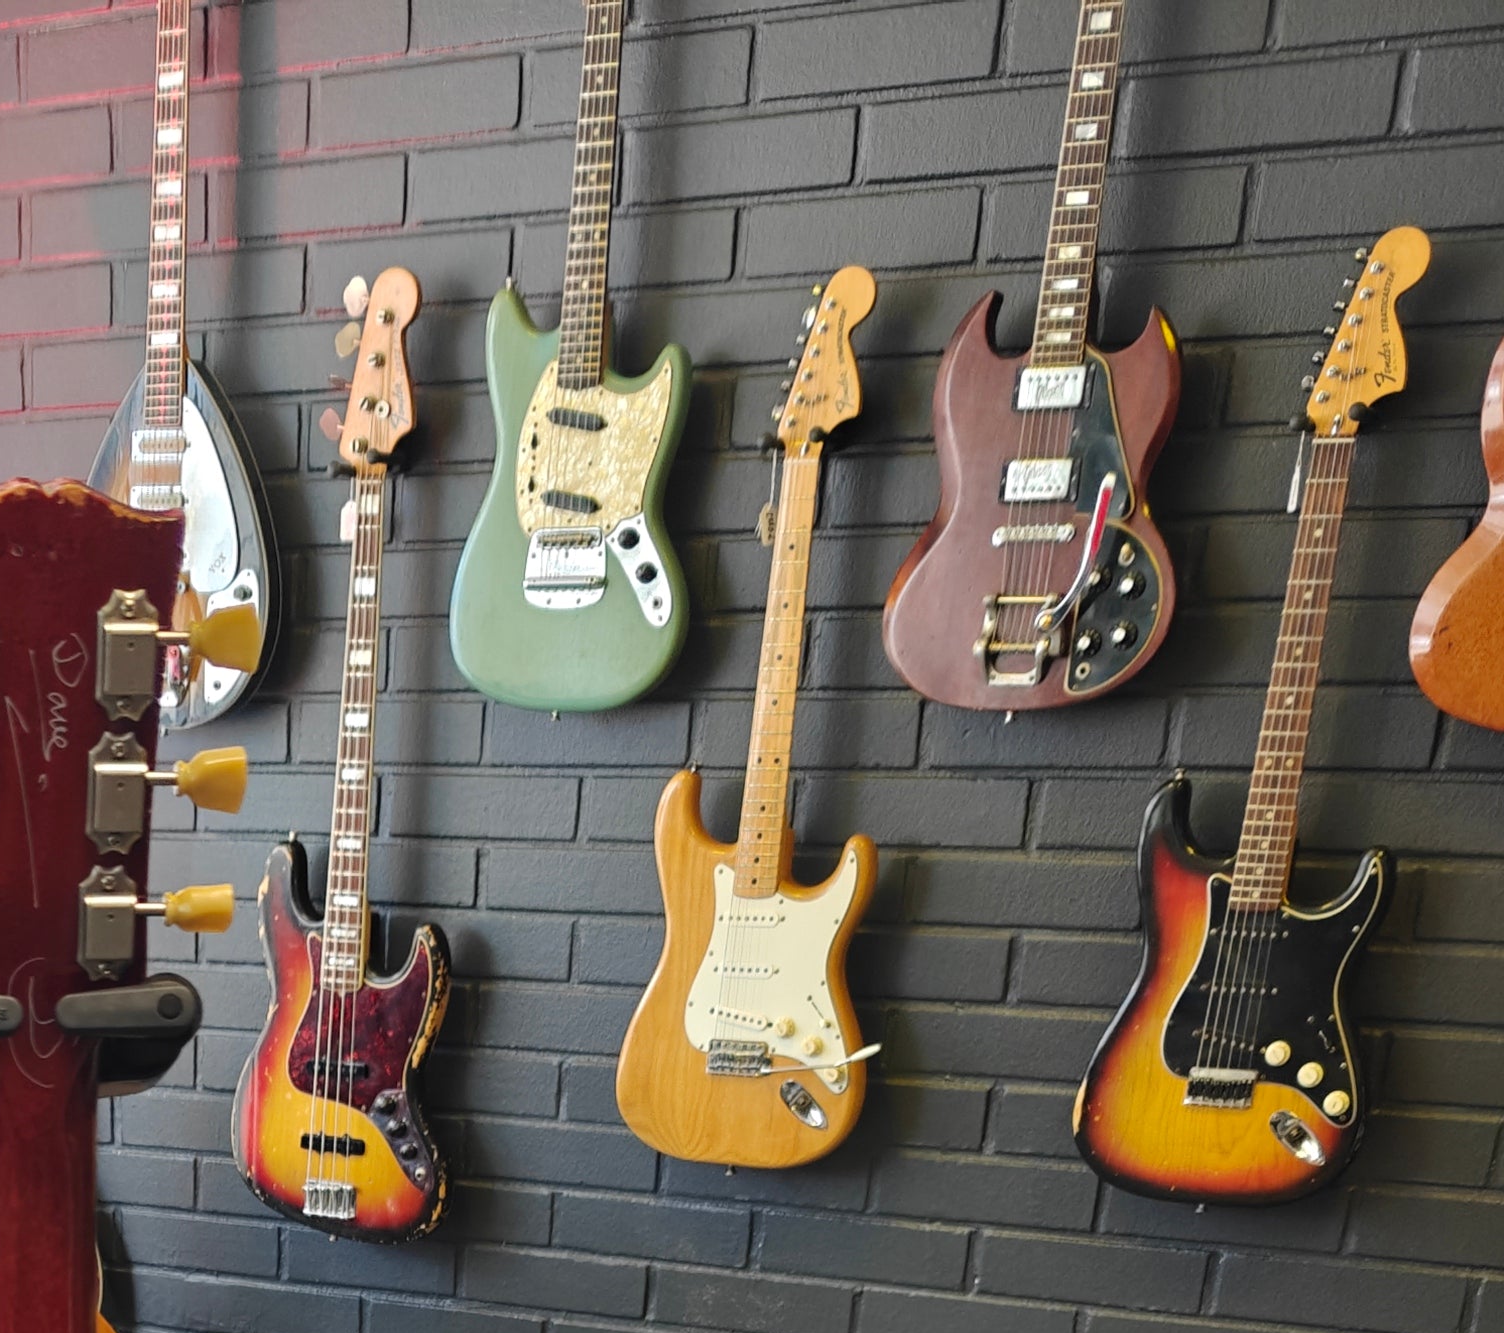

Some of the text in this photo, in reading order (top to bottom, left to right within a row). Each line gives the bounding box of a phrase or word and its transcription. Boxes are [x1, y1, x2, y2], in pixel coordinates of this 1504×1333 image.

[1374, 271, 1397, 388] Fender STRATOCASTER
[208, 552, 227, 573] VOX
